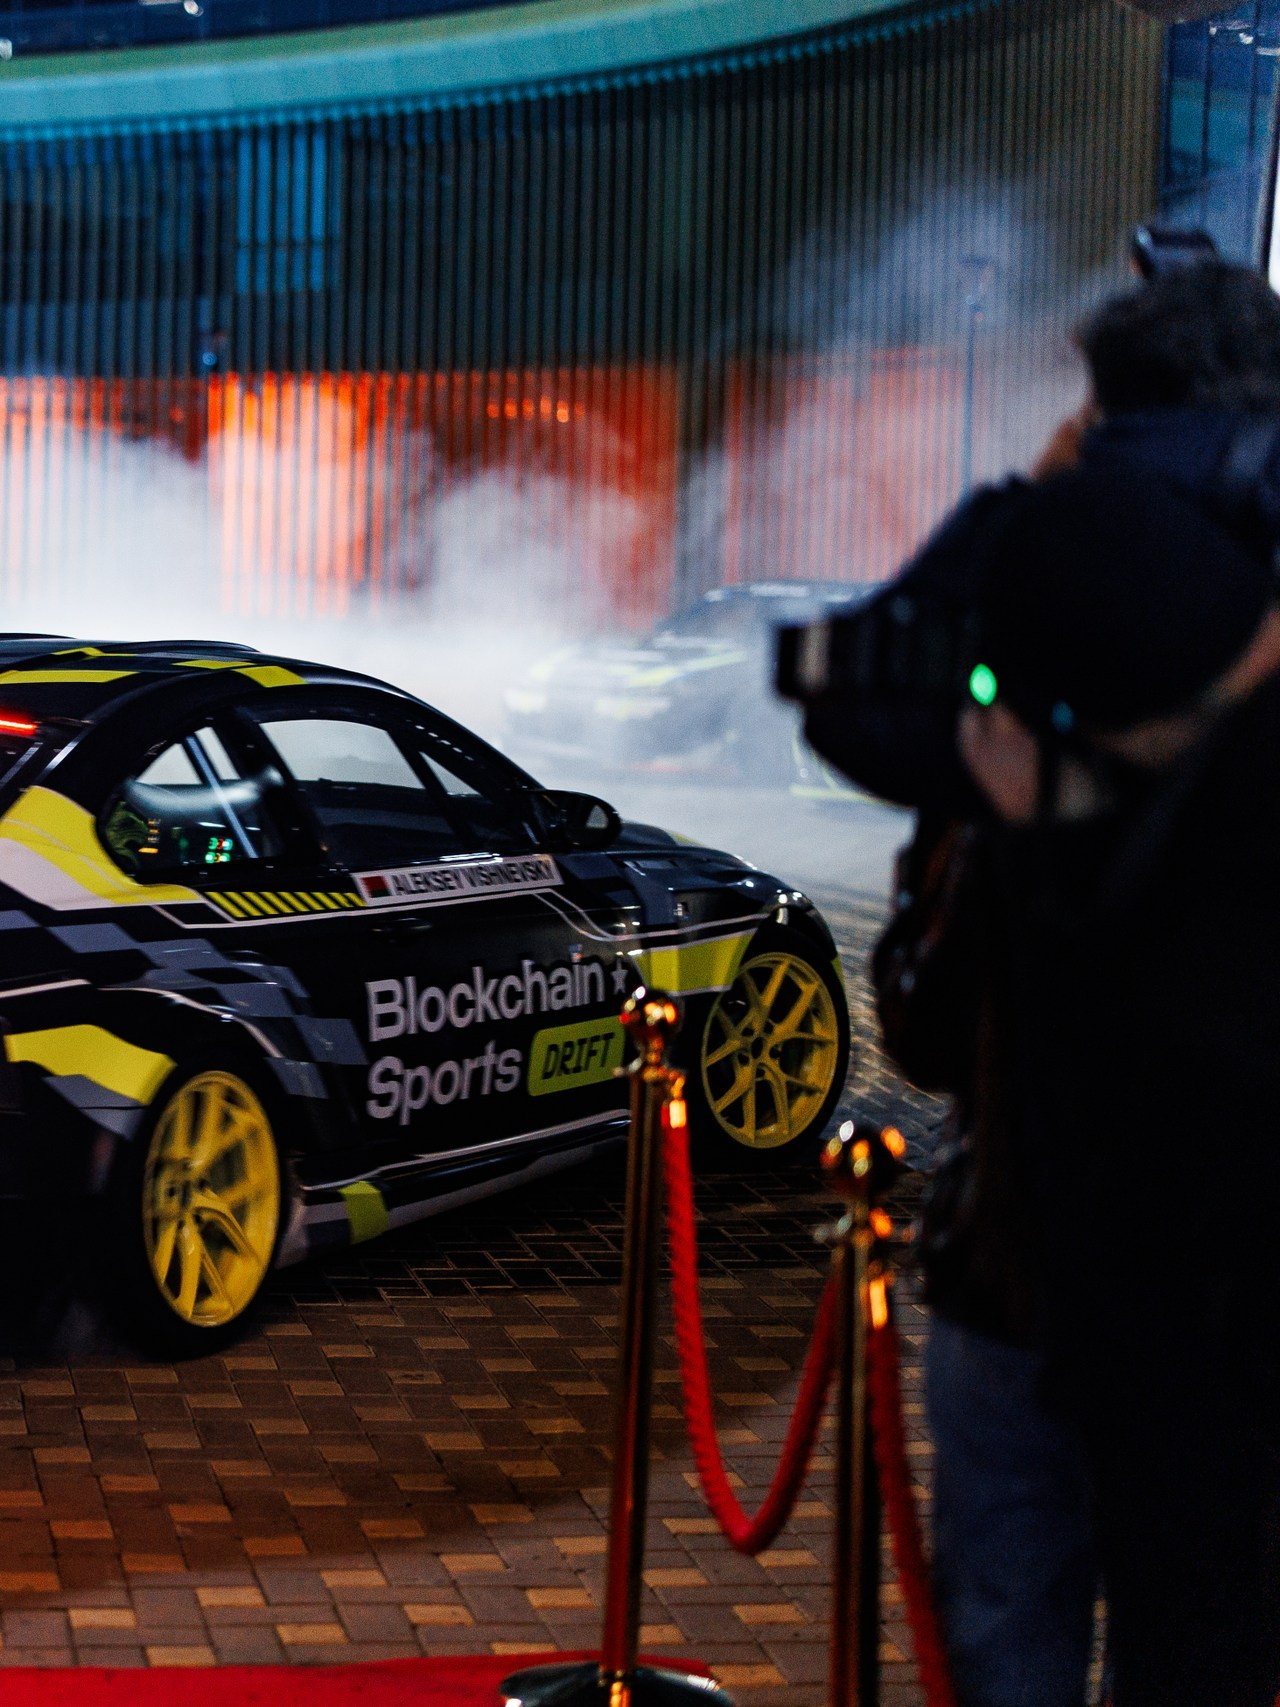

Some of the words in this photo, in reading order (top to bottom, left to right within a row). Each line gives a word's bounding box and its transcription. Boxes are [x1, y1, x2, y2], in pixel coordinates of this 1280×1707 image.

[392, 870, 465, 896] ALEKSEY
[364, 956, 607, 1042] Blockchain
[365, 1040, 524, 1127] Sports
[541, 1032, 615, 1080] DRIFT
